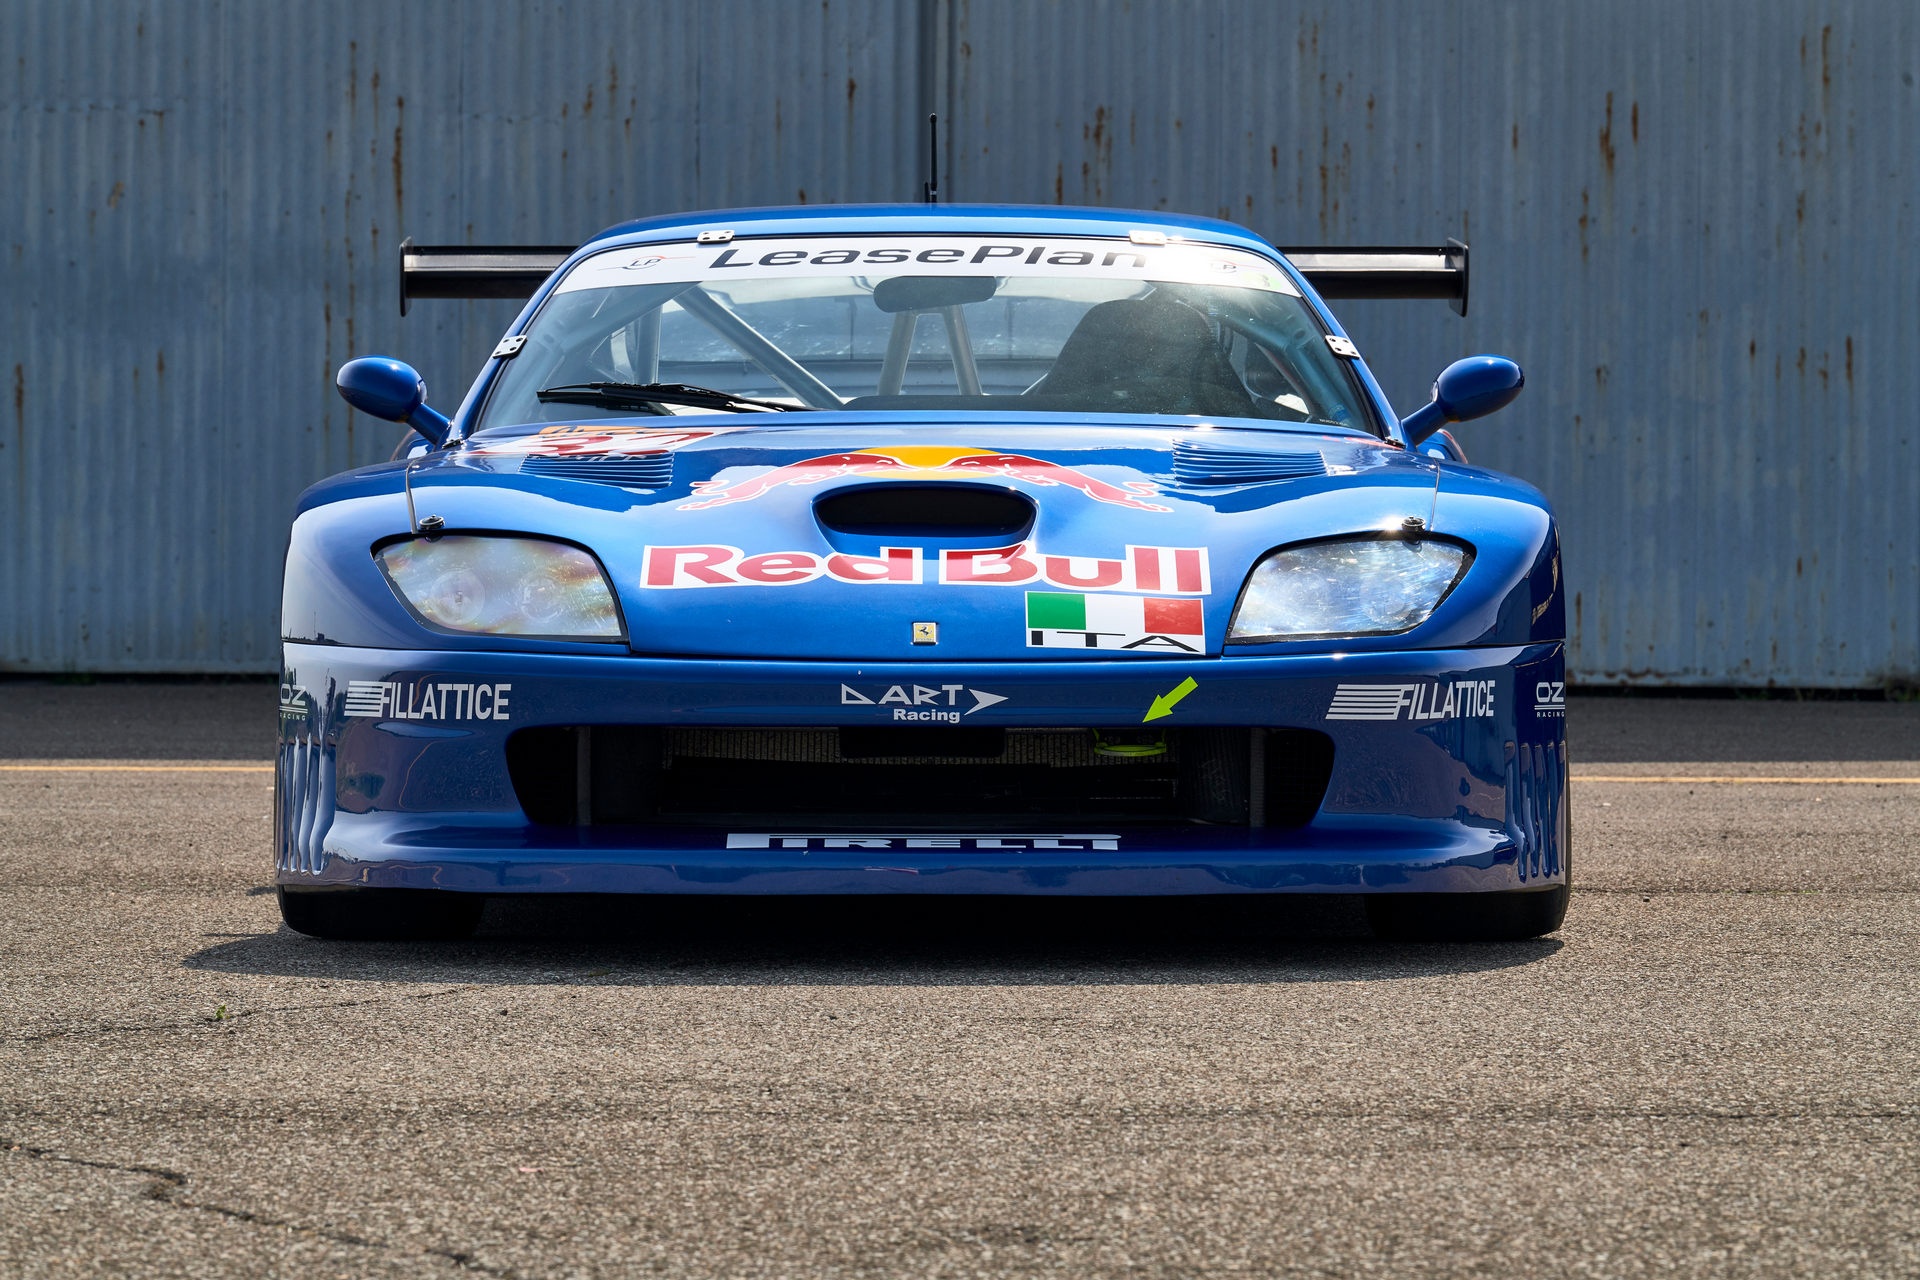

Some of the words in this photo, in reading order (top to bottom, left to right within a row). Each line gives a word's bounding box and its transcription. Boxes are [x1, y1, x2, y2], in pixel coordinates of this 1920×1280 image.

[630, 258, 662, 267] LP
[709, 245, 1147, 269] LeasePlan
[643, 545, 919, 588] Red
[942, 542, 1207, 594] Bull
[1031, 630, 1201, 653] ITA
[281, 683, 306, 706] OZ
[378, 681, 512, 720] FILLATTICE
[841, 683, 964, 706] DART
[1393, 680, 1496, 720] FILLATTICE
[1536, 682, 1565, 703] OZ
[893, 708, 961, 724] Racing
[726, 833, 1122, 850] PIRELLI
